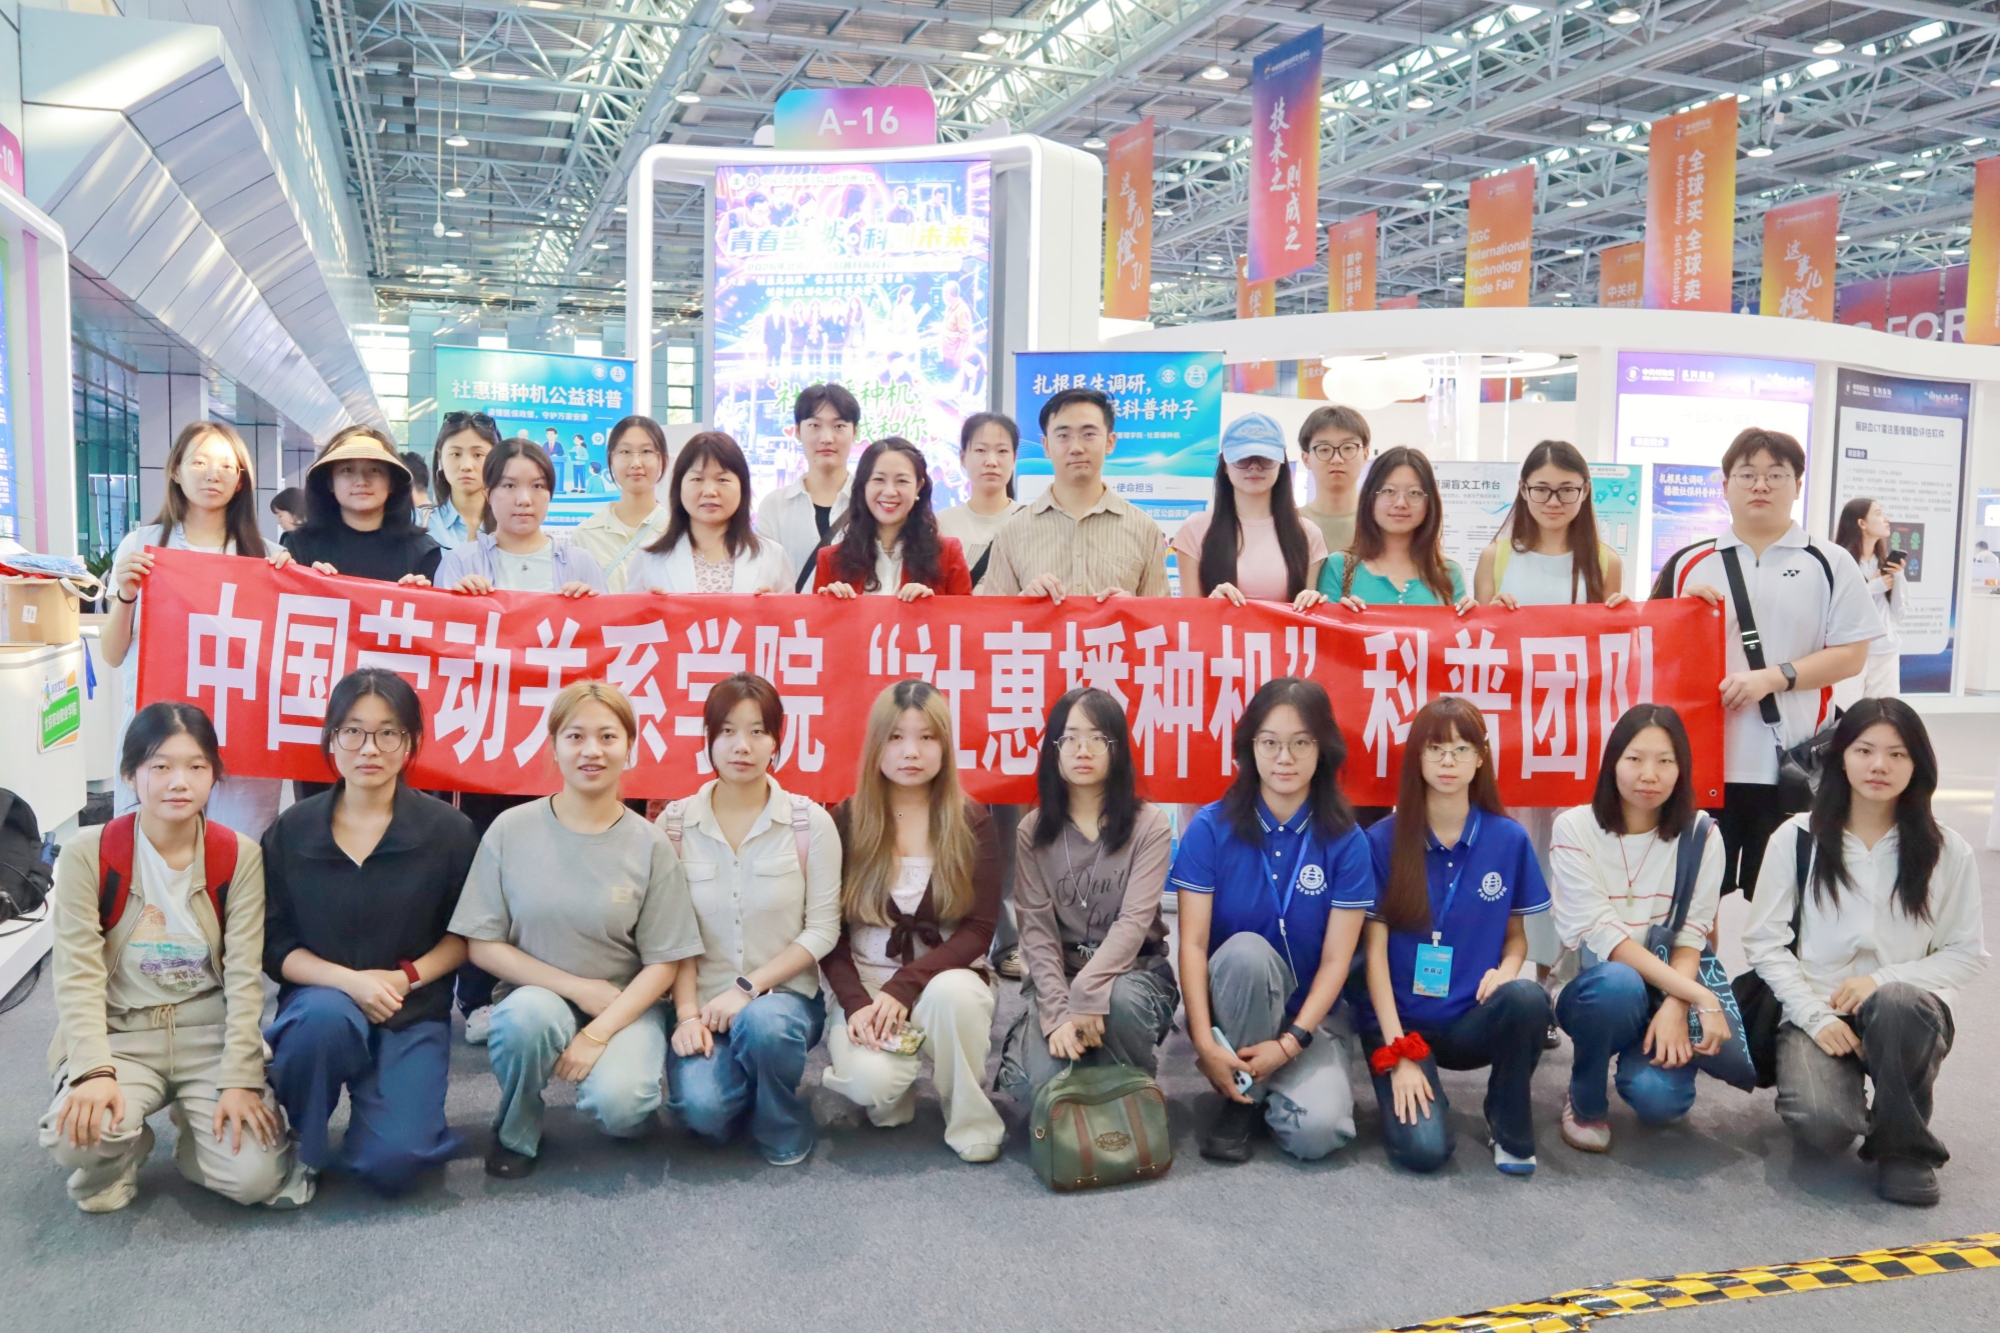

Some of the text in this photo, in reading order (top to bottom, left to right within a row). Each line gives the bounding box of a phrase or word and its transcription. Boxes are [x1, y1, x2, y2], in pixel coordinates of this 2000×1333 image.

[818, 106, 899, 136] A-16
[1470, 228, 1490, 244] ZGC
[1671, 154, 1685, 305] Buy Globally Sell Globally
[1469, 237, 1529, 262] International
[1469, 259, 1523, 280] Technology
[1468, 277, 1516, 297] Trade Fair
[451, 379, 622, 409] 社惠播种机公益科普
[187, 582, 825, 774] 中国劳动关系学院
[1362, 625, 1653, 780] 科普团队
